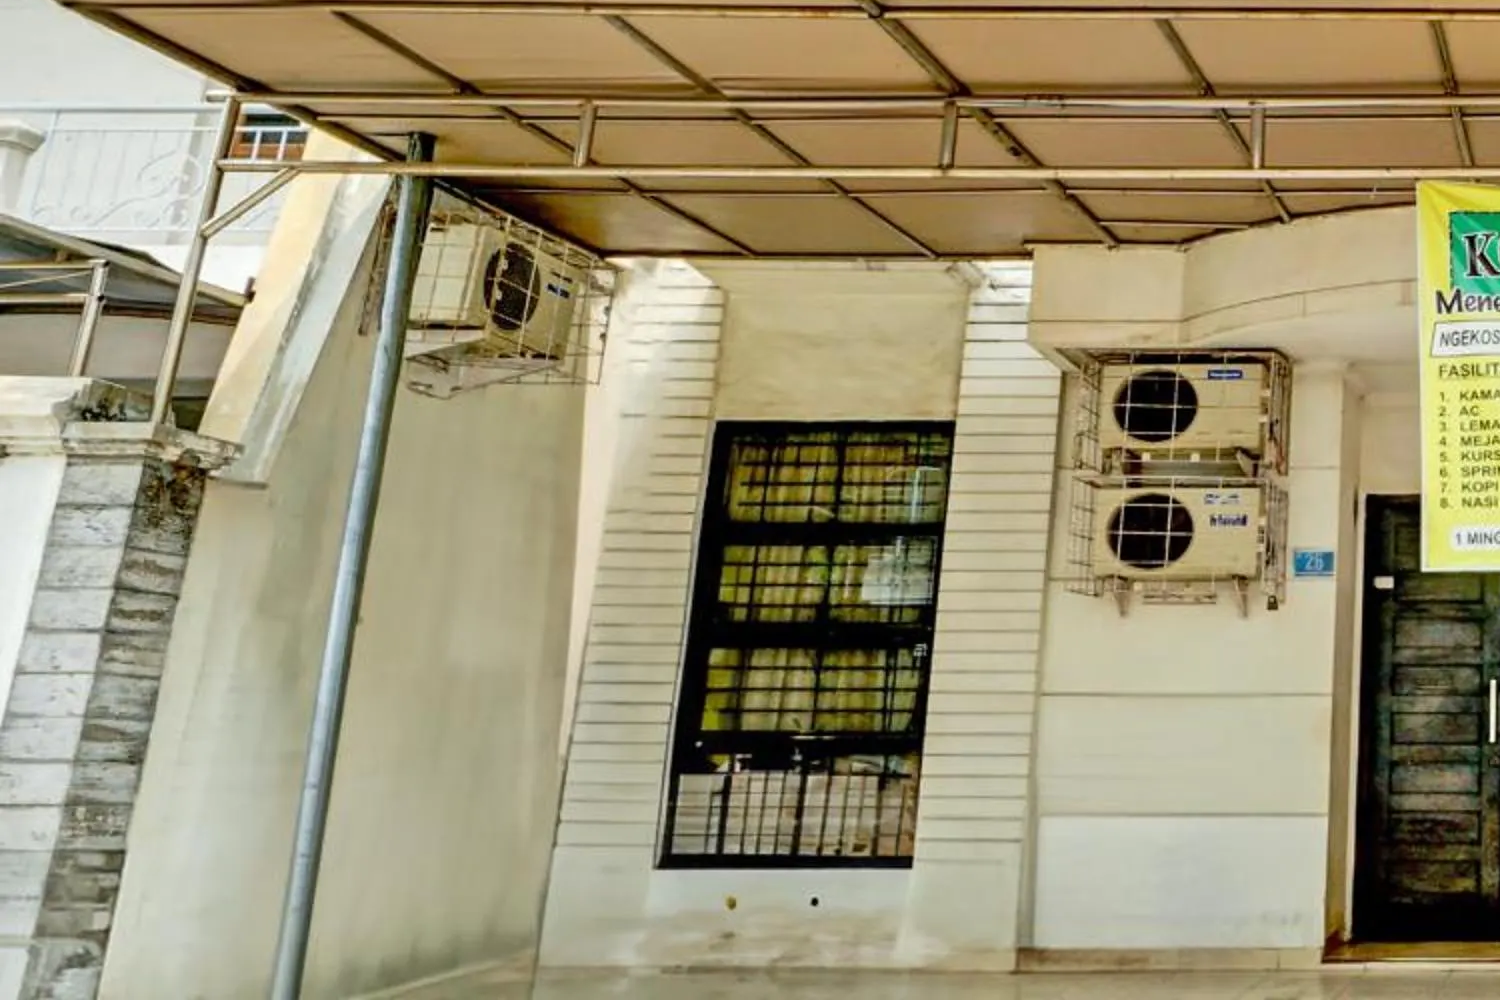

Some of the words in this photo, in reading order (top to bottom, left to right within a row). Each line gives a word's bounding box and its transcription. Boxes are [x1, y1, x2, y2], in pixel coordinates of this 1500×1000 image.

[1459, 405, 1480, 417] AC
[1460, 481, 1499, 493] KOPI
[1461, 496, 1499, 509] NASI
[1455, 533, 1462, 546] 1
